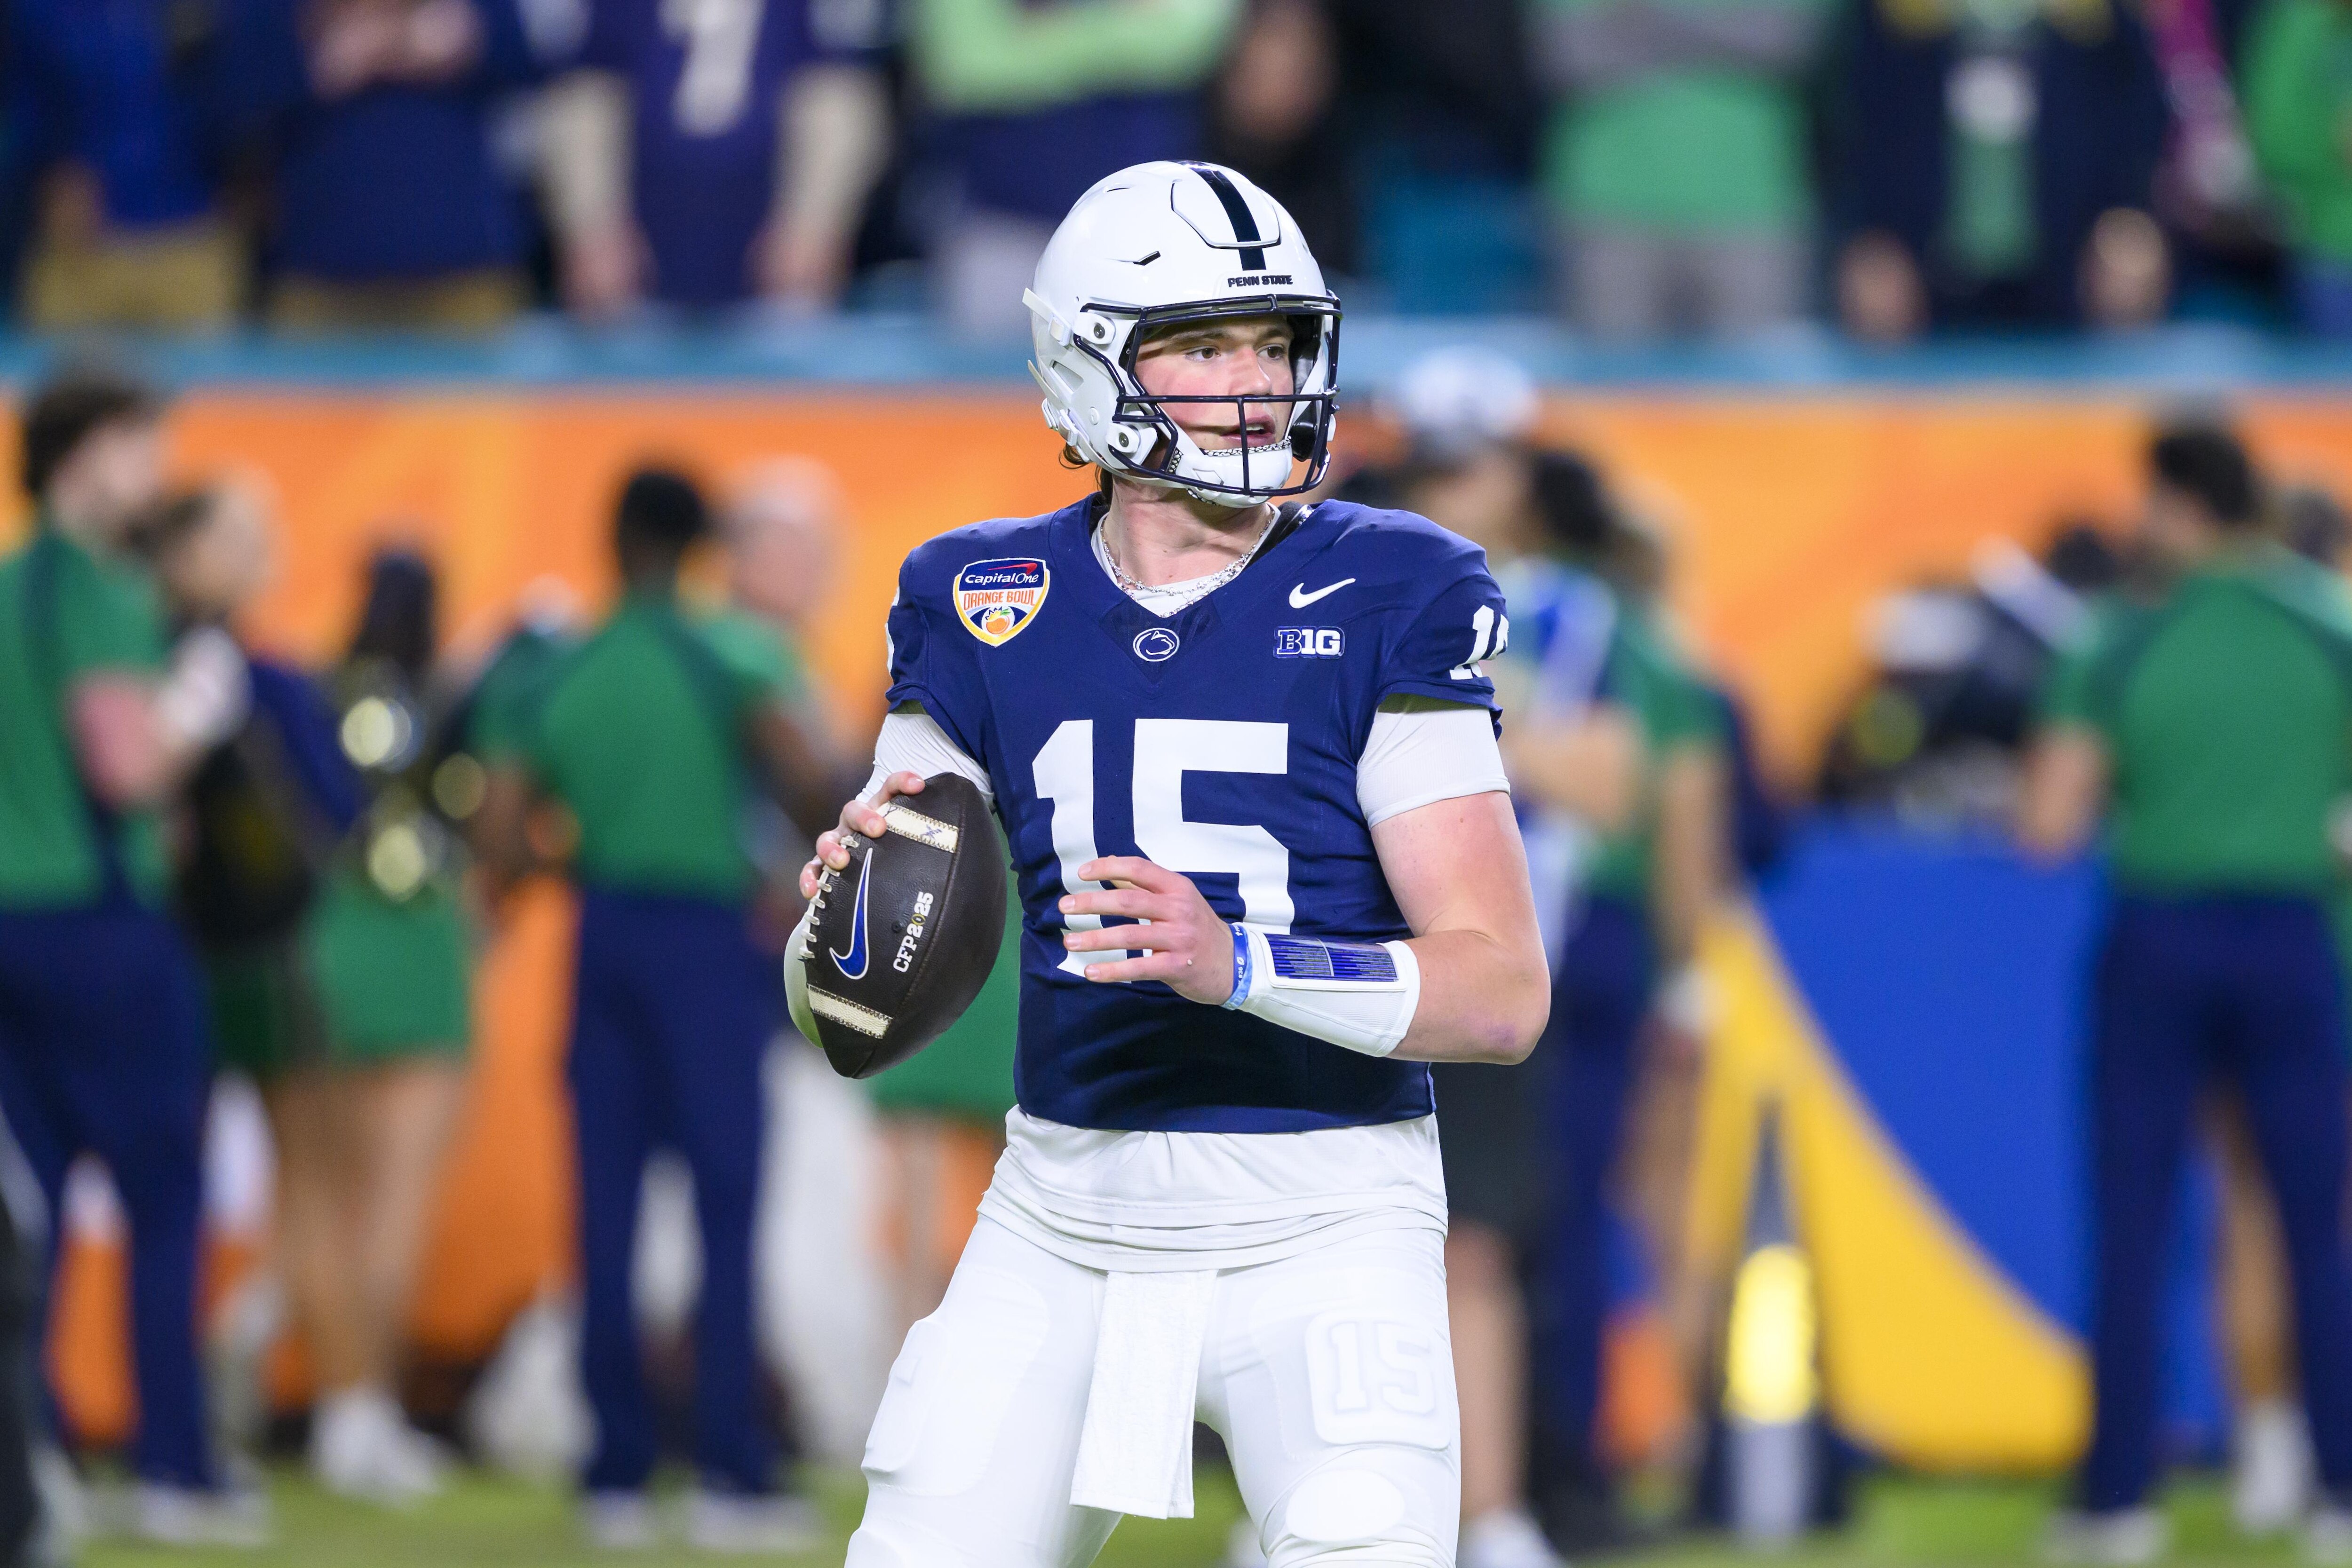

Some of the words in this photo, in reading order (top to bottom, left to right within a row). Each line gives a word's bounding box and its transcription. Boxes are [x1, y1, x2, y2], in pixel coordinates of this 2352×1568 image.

[1227, 276, 1260, 287] PENN
[1261, 275, 1293, 285] STATE
[963, 591, 1004, 610] ORANGE
[1006, 589, 1035, 606] BOWL
[1032, 718, 1295, 984] 15
[1328, 1321, 1435, 1415] 15
